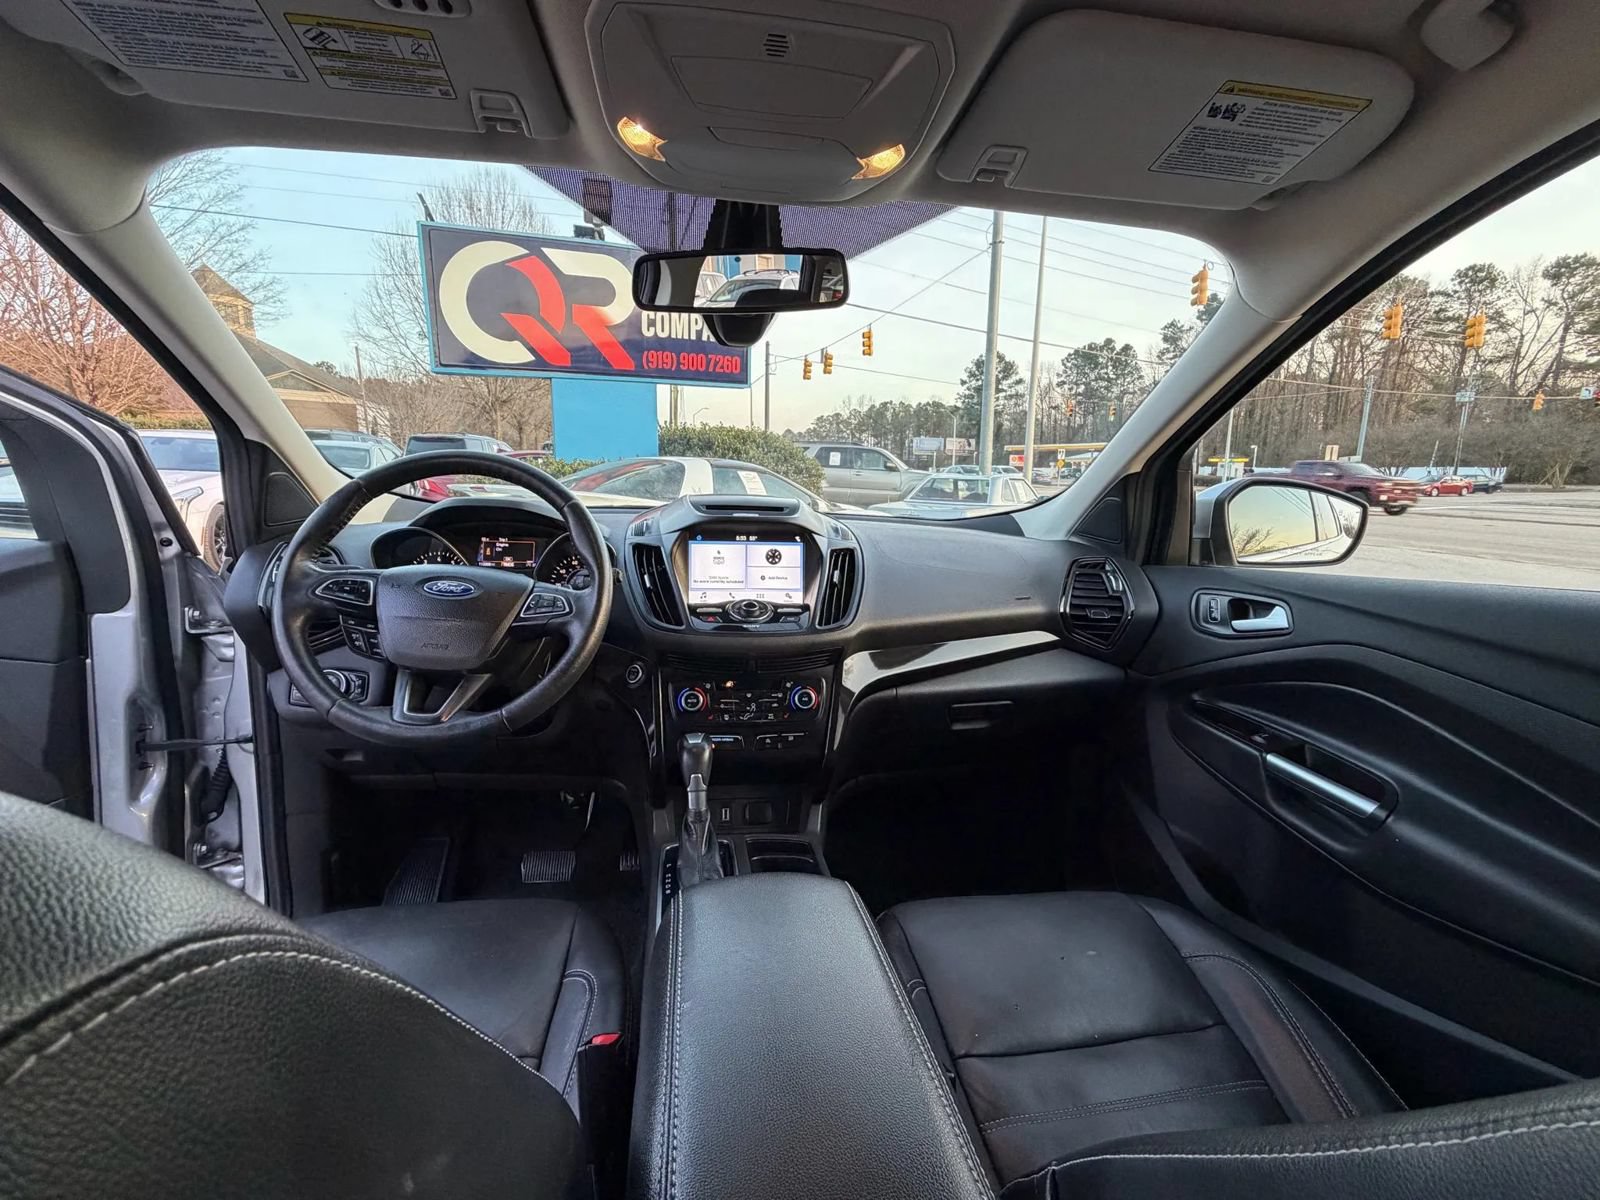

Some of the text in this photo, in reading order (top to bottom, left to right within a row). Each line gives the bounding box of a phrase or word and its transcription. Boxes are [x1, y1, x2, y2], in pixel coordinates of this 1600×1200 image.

[642, 350, 741, 373] (919) 900 7260
[431, 581, 464, 593] Ford
